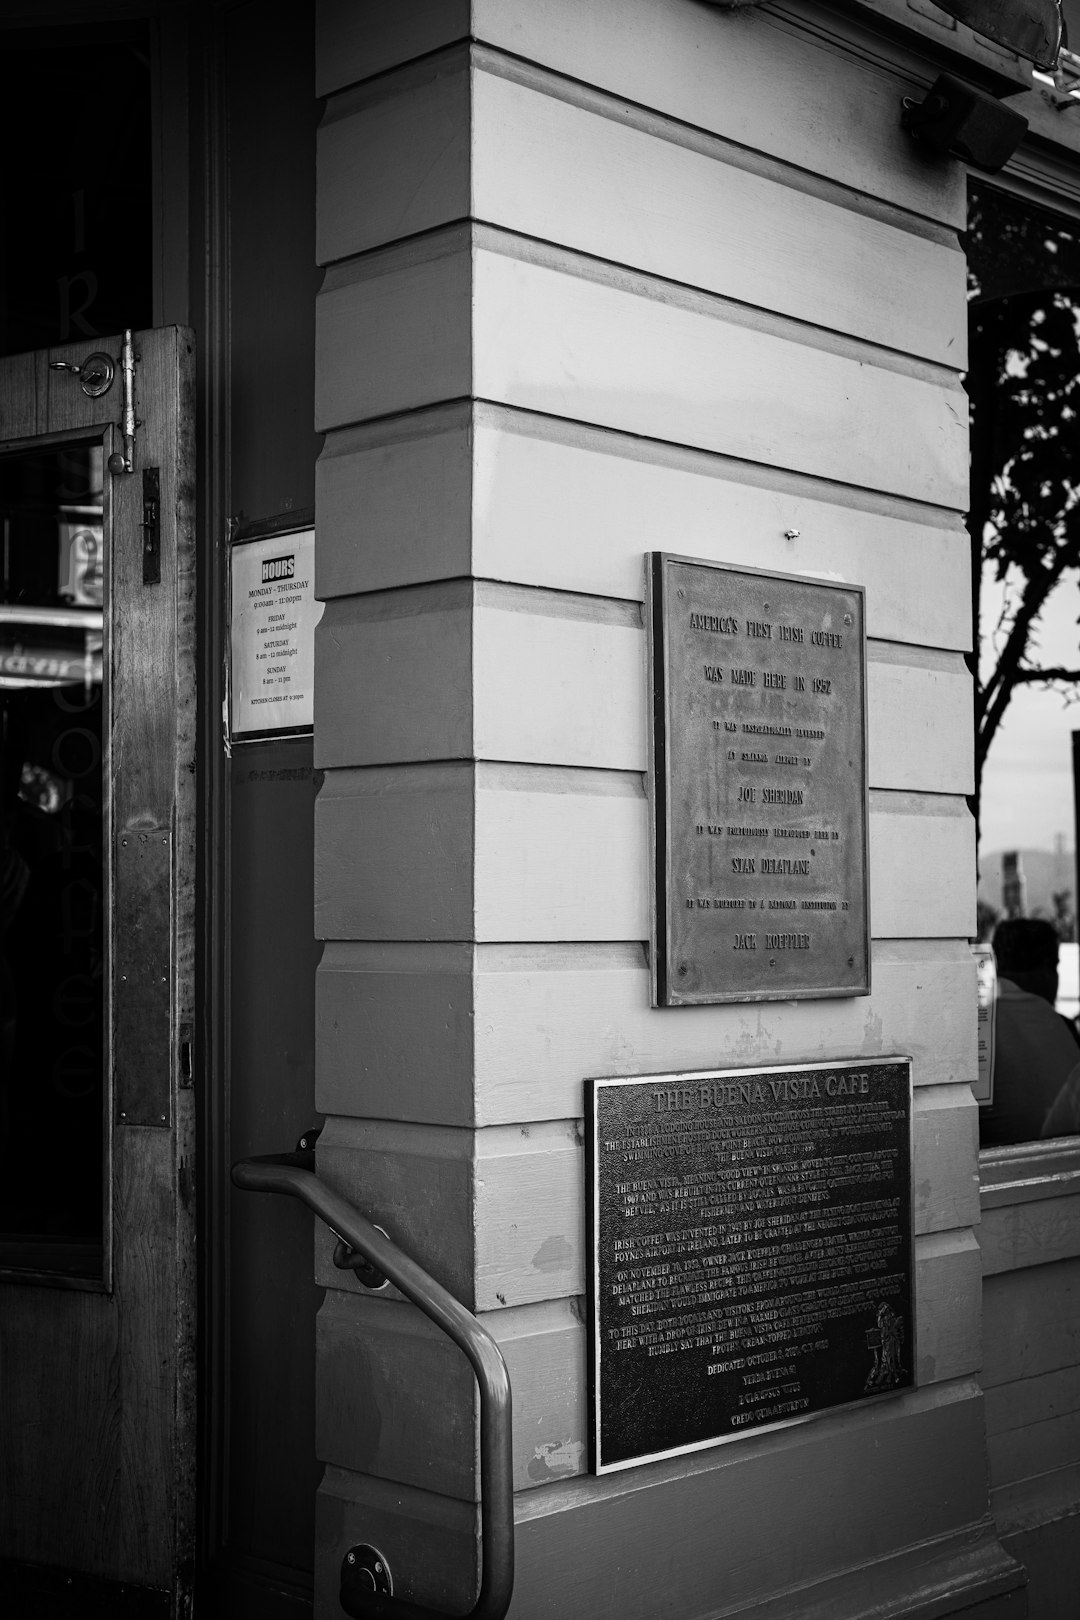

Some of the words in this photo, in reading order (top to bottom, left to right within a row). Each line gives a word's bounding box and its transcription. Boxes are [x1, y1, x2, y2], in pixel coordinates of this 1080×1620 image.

[262, 558, 294, 581] HOURS
[249, 587, 272, 598] MONDAY
[277, 580, 309, 593] THURSDAY
[253, 599, 274, 609] 9:00am
[279, 594, 302, 604] 11:00pm
[268, 613, 286, 622] FRIDAY
[275, 622, 297, 632] midnight
[689, 611, 739, 635] AMERICA'S
[745, 619, 772, 640] FIRST
[779, 624, 804, 644] IRISH
[810, 628, 843, 649] COFFEE
[264, 639, 290, 649] SATURDAY
[276, 648, 298, 658] midnight
[267, 665, 287, 675] SUNDAY
[283, 676, 291, 684] pm
[703, 664, 723, 683] WAS
[730, 667, 756, 687] MADE
[763, 670, 787, 690] HERE
[794, 674, 805, 692] IN
[811, 676, 832, 695] 1952
[711, 719, 720, 731] IT
[723, 720, 737, 733] WAS
[727, 749, 735, 761] AT
[740, 750, 768, 763] SHANNON
[736, 785, 756, 802] JOE
[761, 787, 803, 805] SHERIDAN
[695, 824, 704, 835] IT
[707, 825, 723, 836] WAS
[730, 856, 755, 874] STAN
[760, 857, 809, 875] DELAPLANE
[685, 897, 694, 909] IT
[696, 897, 711, 909] WAS
[767, 898, 797, 910] NATIONAL
[800, 898, 837, 910] INSTITUTION
[732, 932, 757, 950] JACK
[764, 932, 810, 950] KOEPPLER
[653, 1086, 692, 1112] THE
[697, 1080, 765, 1108] BUENA
[768, 1076, 821, 1102] VISTA
[825, 1072, 870, 1097] CAFE
[660, 1119, 693, 1133] LODGING
[694, 1117, 717, 1130] HOUSE
[732, 1112, 762, 1126] SALOON
[604, 1138, 619, 1152] THE
[621, 1132, 682, 1150] ESTABLISHMENT
[682, 1129, 710, 1143] HOSTED
[622, 1146, 663, 1162] SWIMMING
[615, 1181, 631, 1194] THE
[631, 1178, 657, 1192] BUENA
[682, 1170, 716, 1185] MEANING
[640, 1190, 657, 1203] AND
[674, 1183, 704, 1198] REBUILT
[726, 1176, 758, 1191] CURRENT
[659, 1200, 670, 1212] AS
[670, 1199, 679, 1211] IT
[679, 1198, 687, 1209] IS
[699, 1201, 739, 1218] FISHERMEN
[613, 1236, 635, 1251] IRISH
[635, 1232, 665, 1247] COFFEE
[664, 1229, 681, 1243] WAS
[681, 1224, 718, 1240] INVENTED
[718, 1223, 726, 1234] IN
[752, 1217, 766, 1229] JOE
[614, 1247, 644, 1263] FOYNES
[644, 1242, 675, 1258] AIRPORT
[676, 1240, 686, 1253] IN
[721, 1232, 742, 1245] LATER
[743, 1230, 753, 1242] TO
[763, 1224, 793, 1238] CRAFTED
[616, 1269, 627, 1282] ON
[628, 1262, 671, 1280] NOVEMBER
[701, 1253, 727, 1268] OWNER
[611, 1276, 656, 1296] DELAPLANE
[656, 1274, 668, 1287] TO
[705, 1265, 720, 1279] THE
[617, 1288, 655, 1306] MATCHED
[655, 1286, 670, 1299] THE
[671, 1279, 708, 1296] FLAWLESS
[735, 1271, 751, 1284] THIS
[630, 1298, 669, 1316] SHERIDAN
[669, 1293, 696, 1309] WOULD
[697, 1285, 737, 1304] IMMIGRATE
[747, 1278, 777, 1294] AMERICA
[607, 1327, 620, 1340] TO
[620, 1323, 639, 1338] THIS
[656, 1315, 678, 1331] BOTH
[677, 1310, 706, 1326] LOCALS
[705, 1307, 723, 1321] AND
[722, 1301, 755, 1317] VISITORS
[754, 1297, 774, 1311] FROM
[774, 1292, 802, 1307] AROUND
[615, 1335, 638, 1351] HERE
[637, 1331, 658, 1346] WITH
[657, 1330, 665, 1342] A
[665, 1326, 686, 1341] DROP
[696, 1320, 717, 1334] IRISH
[748, 1307, 779, 1324] WARMED
[647, 1339, 678, 1357] HUMBLY
[679, 1336, 694, 1350] SAY
[693, 1332, 713, 1347] THAT
[713, 1329, 728, 1343] THE
[727, 1324, 753, 1340] BUENA
[752, 1320, 772, 1334] VISTA
[706, 1354, 746, 1375] DEDICATED
[746, 1348, 777, 1366] OCTOBER
[741, 1369, 766, 1386] YERBA
[765, 1364, 789, 1380] BUENA
[729, 1408, 754, 1426] CREDO
